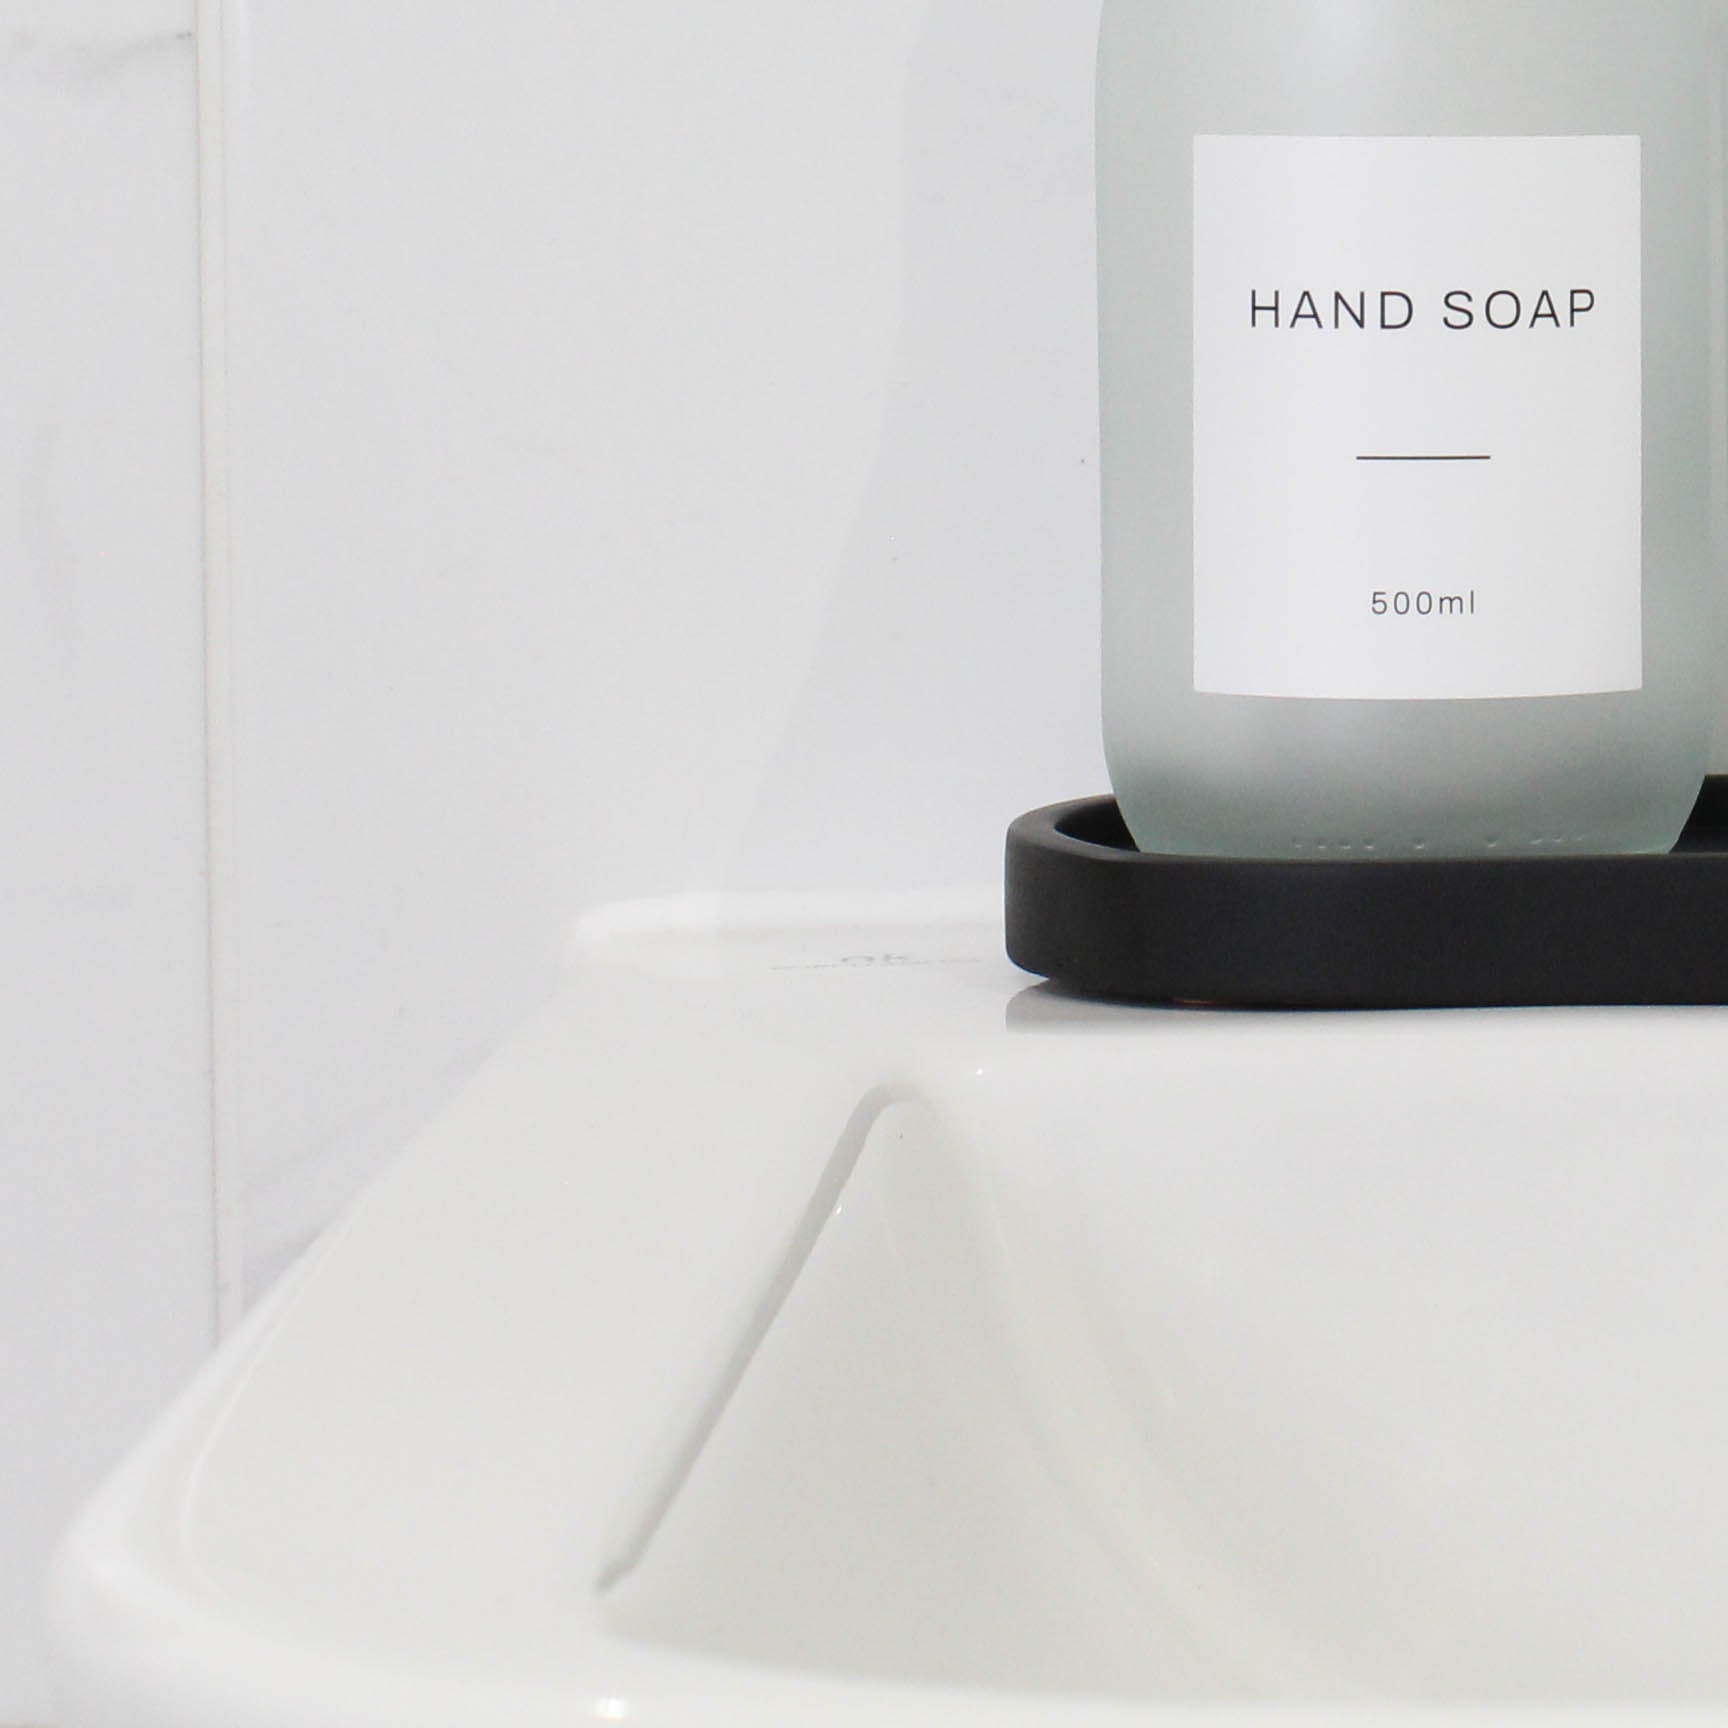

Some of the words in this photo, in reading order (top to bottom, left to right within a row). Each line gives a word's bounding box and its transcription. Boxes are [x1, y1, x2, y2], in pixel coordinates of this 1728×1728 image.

[1250, 288, 1415, 331] HAND
[1441, 287, 1596, 331] SOAP
[1370, 589, 1475, 617] 500ml
